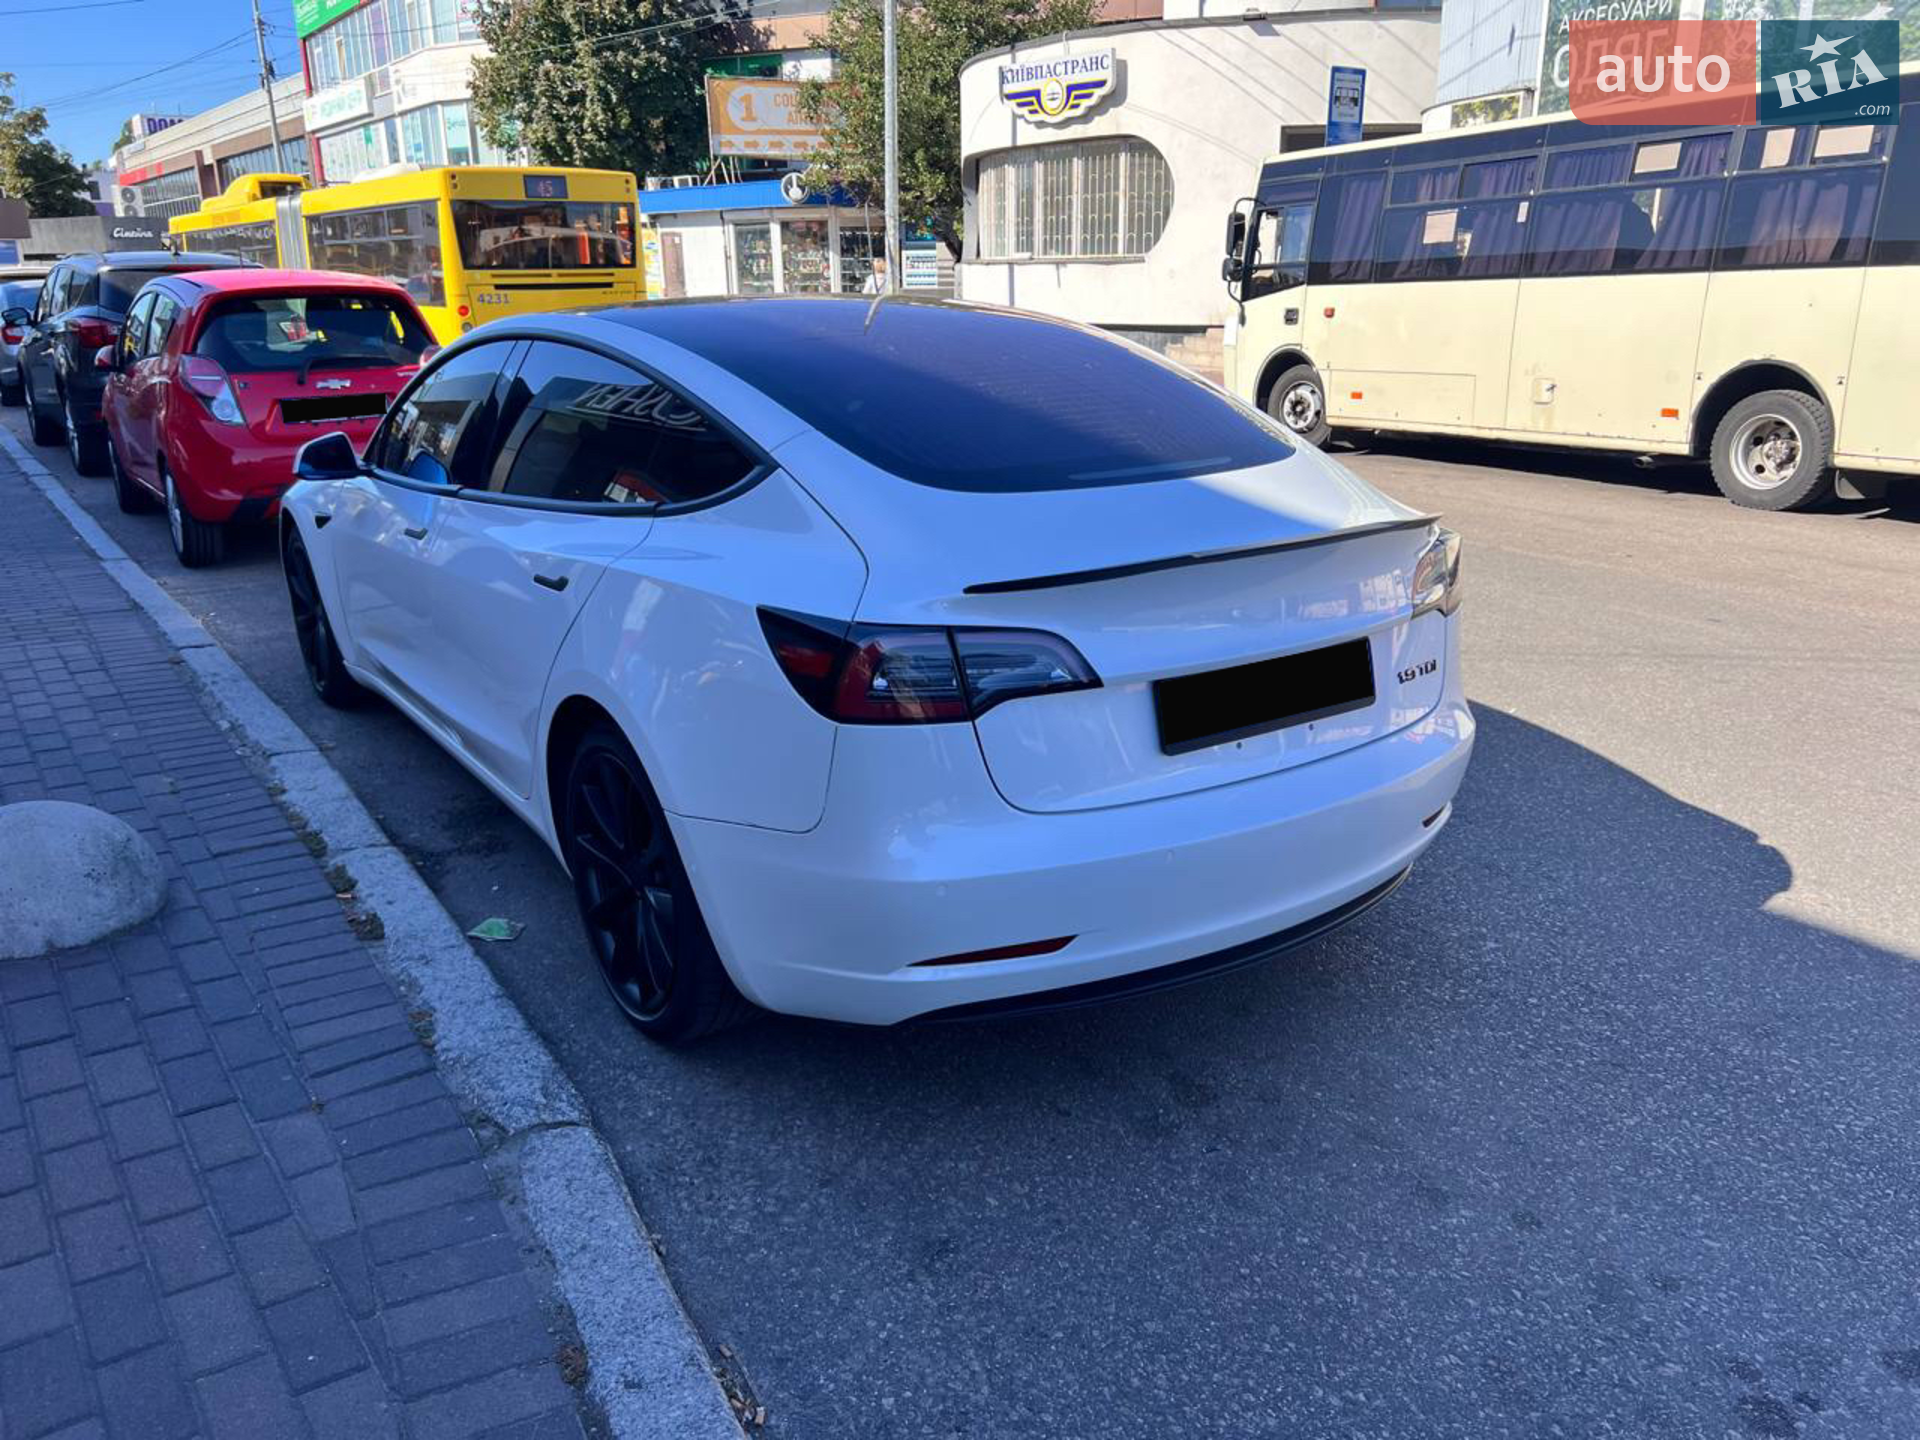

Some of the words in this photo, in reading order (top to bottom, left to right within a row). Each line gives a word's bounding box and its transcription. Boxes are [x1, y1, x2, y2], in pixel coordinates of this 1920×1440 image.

[1001, 54, 1110, 85] КИЇВПАСТРАНС
[477, 293, 511, 304] 4231
[1416, 659, 1437, 676] TDI
